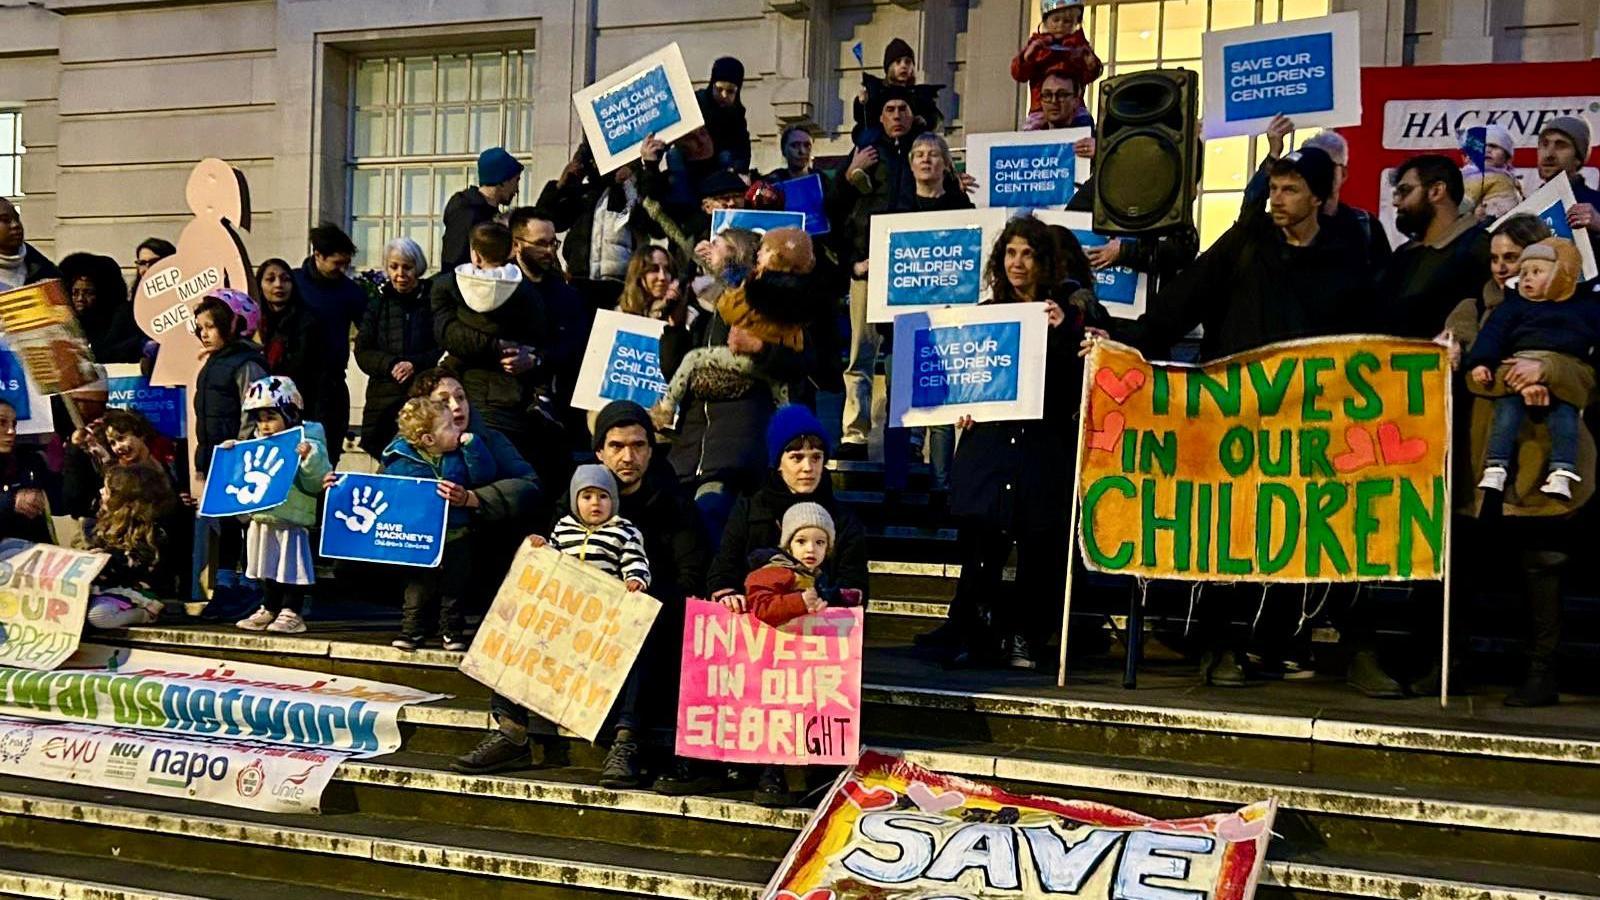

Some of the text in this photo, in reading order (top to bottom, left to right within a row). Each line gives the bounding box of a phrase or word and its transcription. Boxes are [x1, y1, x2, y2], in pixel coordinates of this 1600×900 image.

[1231, 53, 1311, 73] SAVE OUR
[1231, 66, 1326, 87] CHILDREN'S
[600, 84, 655, 119] SAVE OUR
[1231, 83, 1308, 102] CENTRES
[604, 90, 668, 129] CHILDREN'S
[608, 107, 660, 139] CENTRES
[995, 157, 1059, 169] SAVE OUR
[995, 168, 1070, 181] CHILDREN'S
[995, 181, 1056, 193] CENTRES
[894, 245, 962, 259] SAVE OUR
[894, 260, 975, 274] CHILDREN'S
[145, 269, 218, 300] HELP MUMS
[893, 275, 958, 288] CENTRES
[152, 304, 189, 333] SAVE
[617, 346, 656, 363] SAVE
[921, 340, 998, 358] SAVE OUR
[920, 355, 1012, 372] CHILDREN'S
[920, 371, 992, 387] CENTRES
[1151, 352, 1441, 421] INVEST
[1121, 425, 1336, 478] IN OUR
[375, 530, 434, 543] HACKNEY'S
[376, 522, 403, 532] SAVE
[1082, 475, 1444, 578] CHILDREN
[518, 564, 621, 636] HANDS
[517, 603, 625, 670] OFF OUR
[694, 613, 858, 664] INVEST
[707, 662, 854, 712] IN OUR
[0, 668, 379, 751] wardsnetwork
[684, 705, 850, 758] SEBRIGHT
[41, 737, 101, 764] CWU
[110, 742, 145, 759] NUJ
[149, 748, 229, 787] napo
[272, 783, 304, 800] unite
[841, 813, 1217, 900] SAVE
